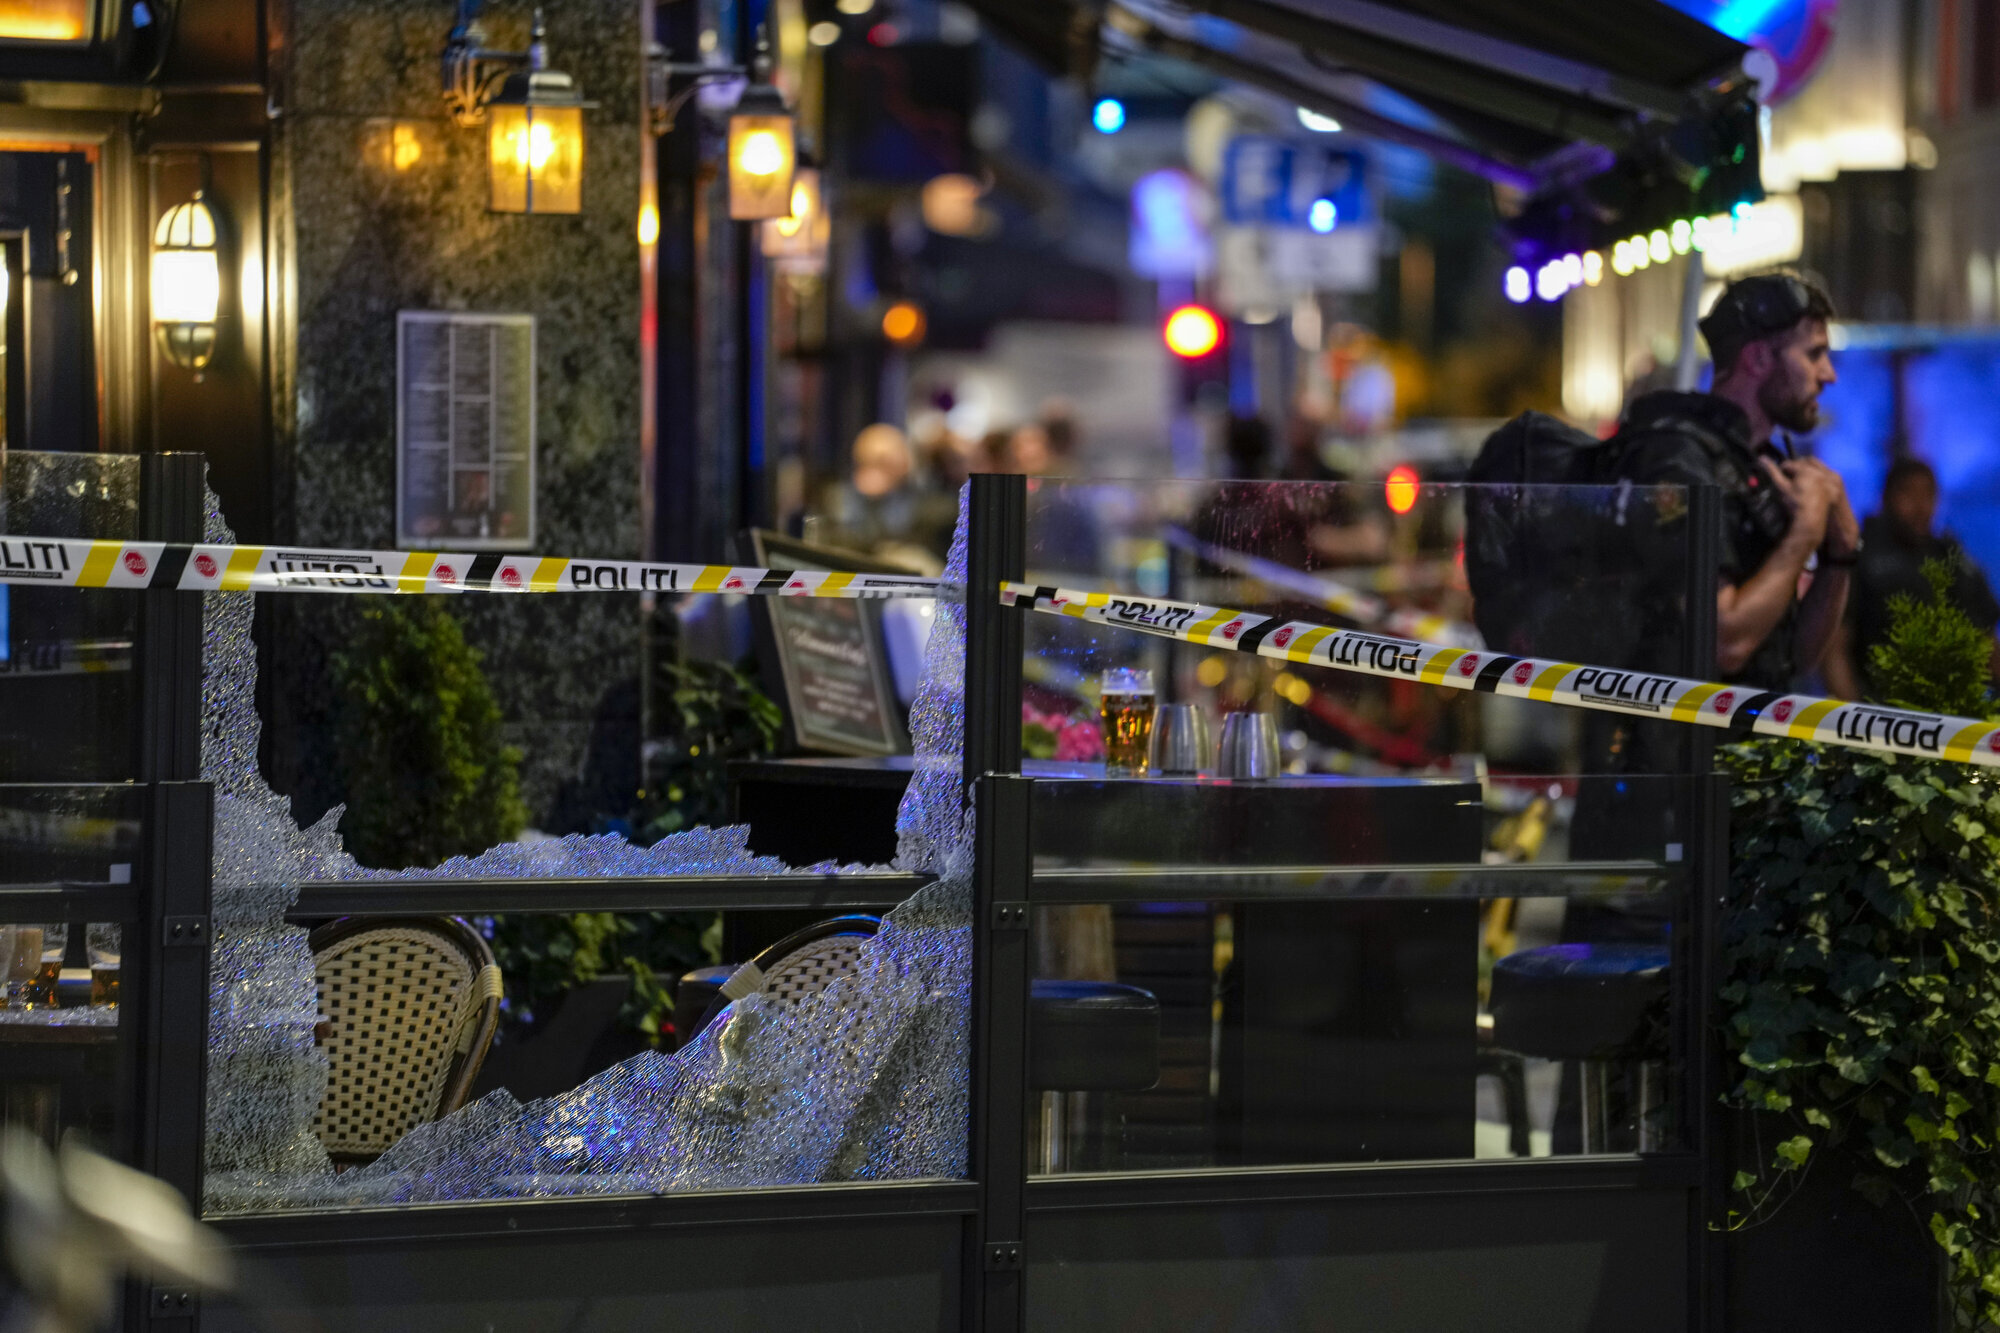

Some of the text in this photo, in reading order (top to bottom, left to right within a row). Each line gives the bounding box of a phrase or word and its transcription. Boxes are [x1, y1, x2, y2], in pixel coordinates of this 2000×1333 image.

[0, 541, 70, 571] LITI
[571, 565, 678, 592] POLITI
[1329, 637, 1422, 675] POLITI
[1573, 668, 1678, 704] POLITI
[1837, 711, 1944, 751] POLITI
